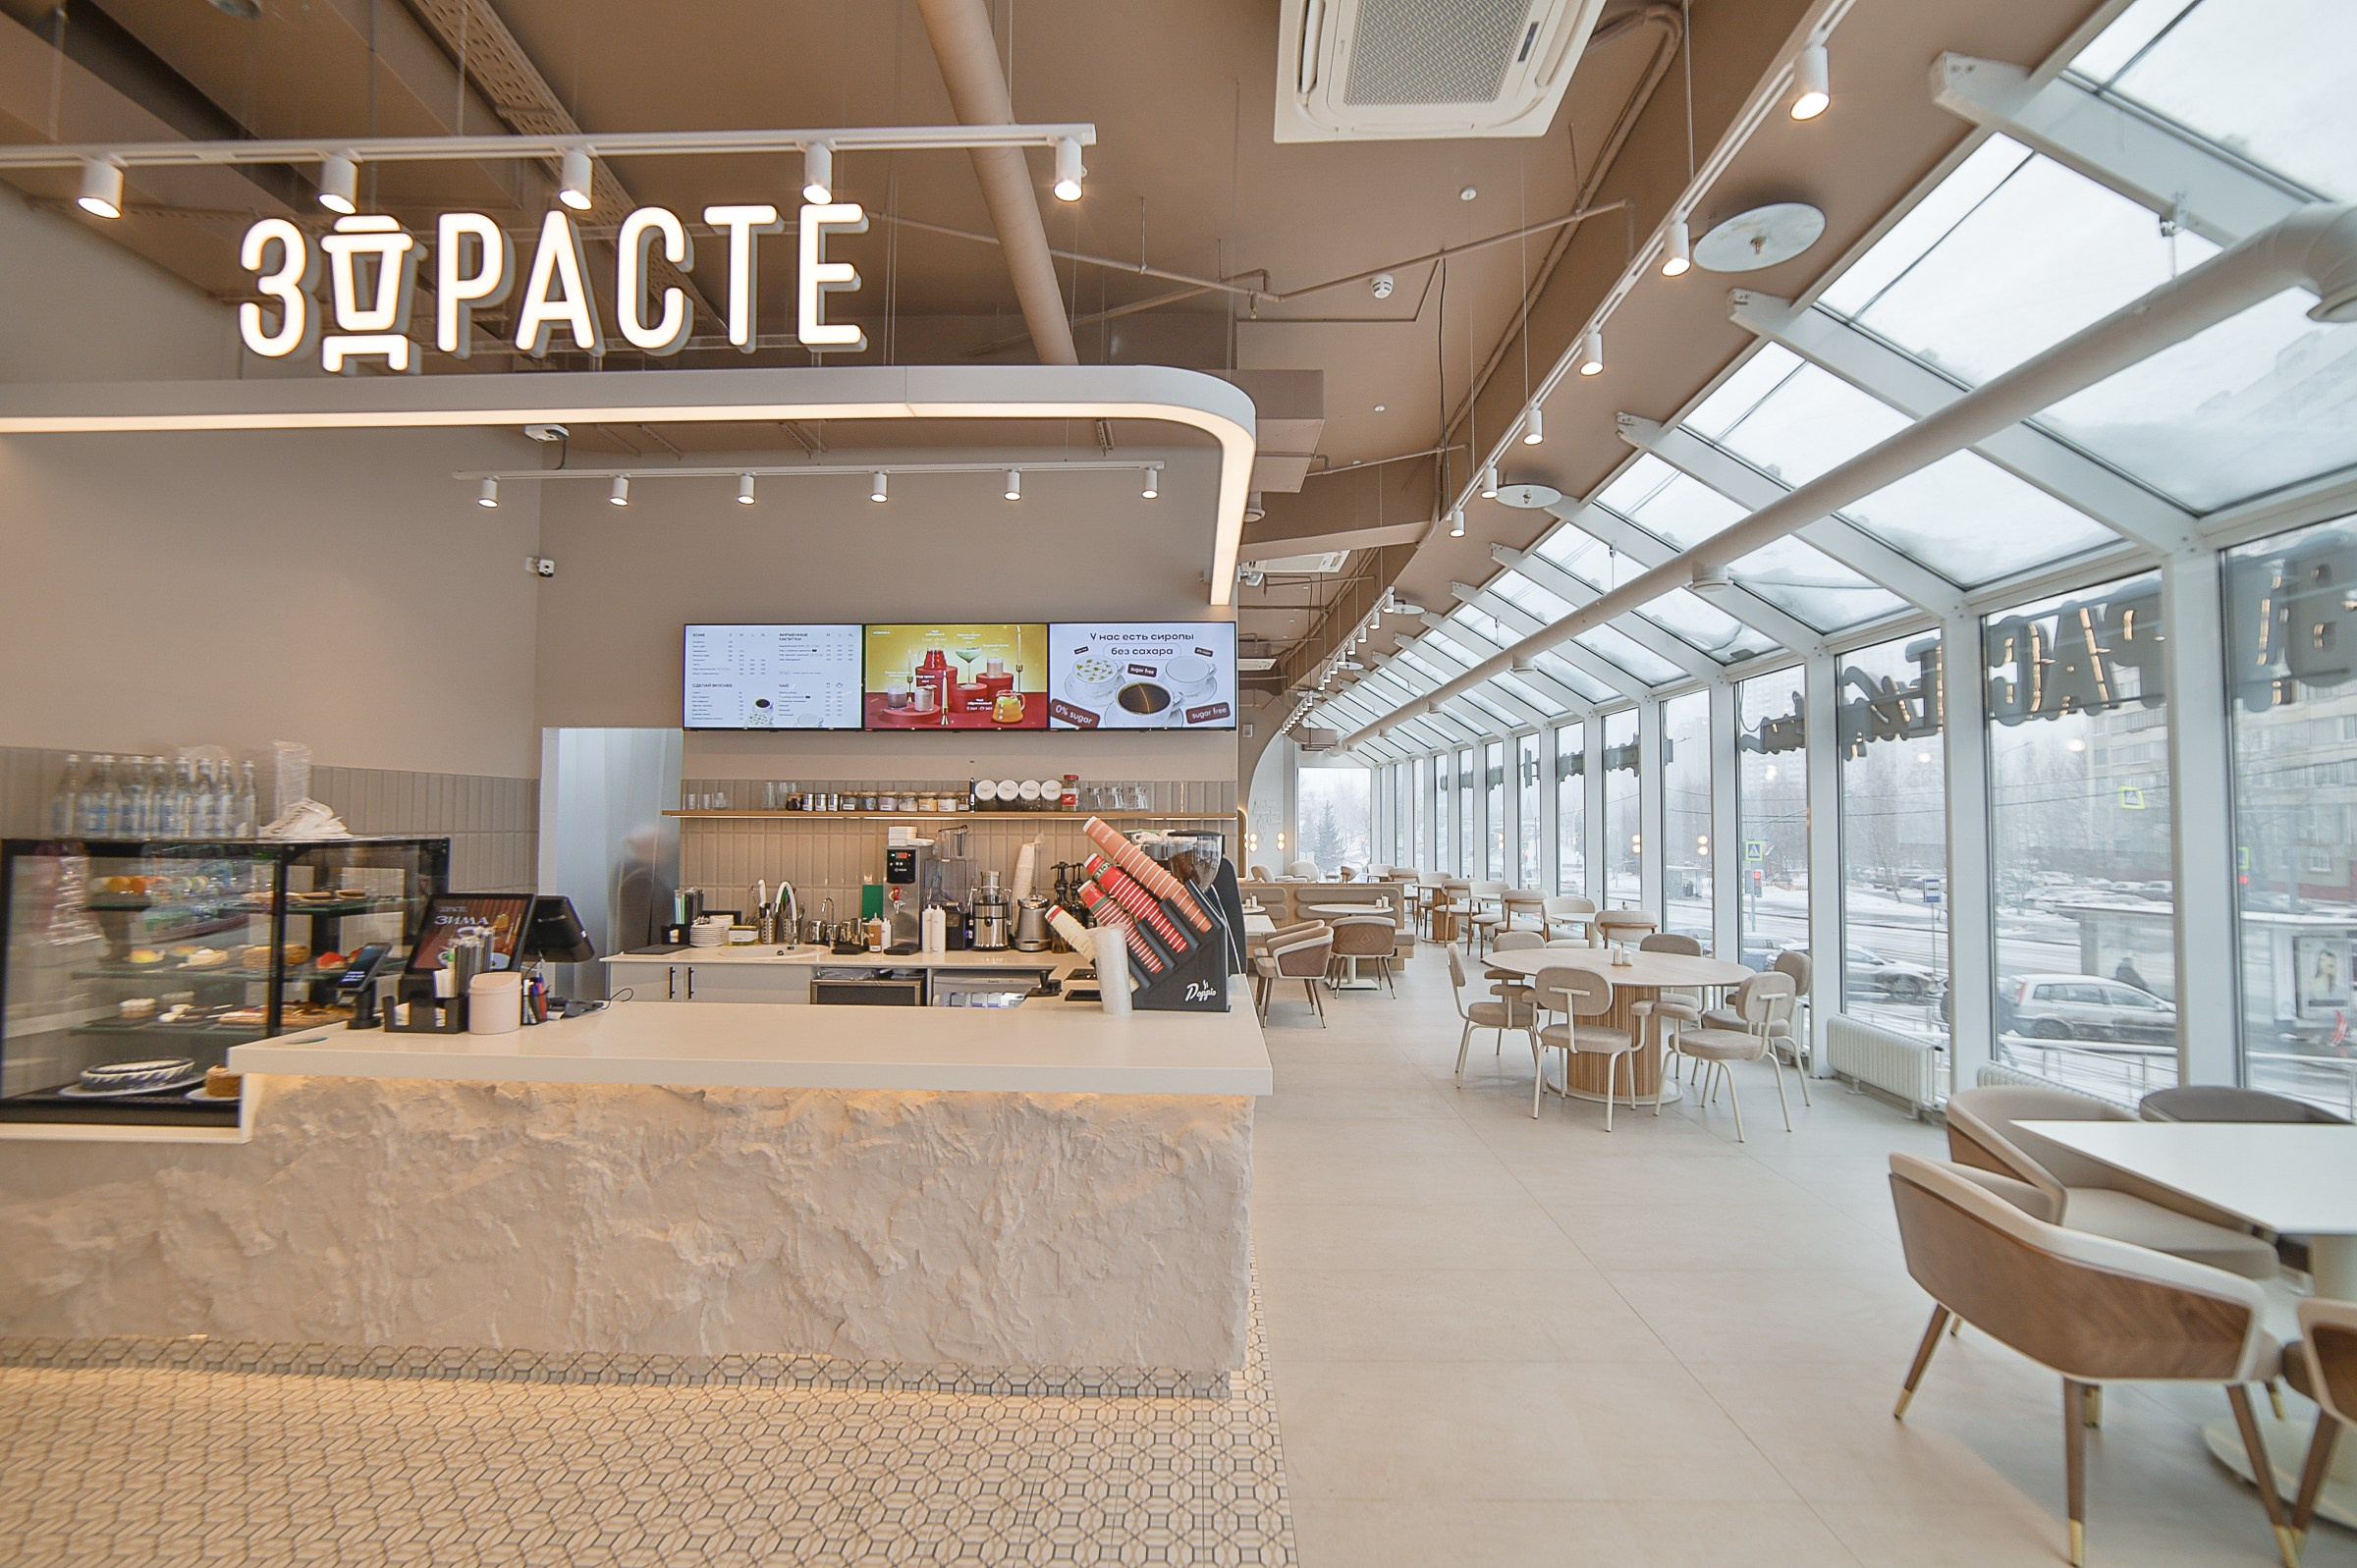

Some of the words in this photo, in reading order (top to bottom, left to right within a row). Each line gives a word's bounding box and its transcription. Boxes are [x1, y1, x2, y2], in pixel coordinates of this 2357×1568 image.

[239, 202, 868, 372] ЗДРАСТЕ
[1150, 633, 1194, 642] сиропы
[1055, 704, 1069, 716] 0%
[1069, 711, 1093, 725] sugar
[1191, 709, 1212, 720] sugar
[434, 915, 490, 925] ЗИМА
